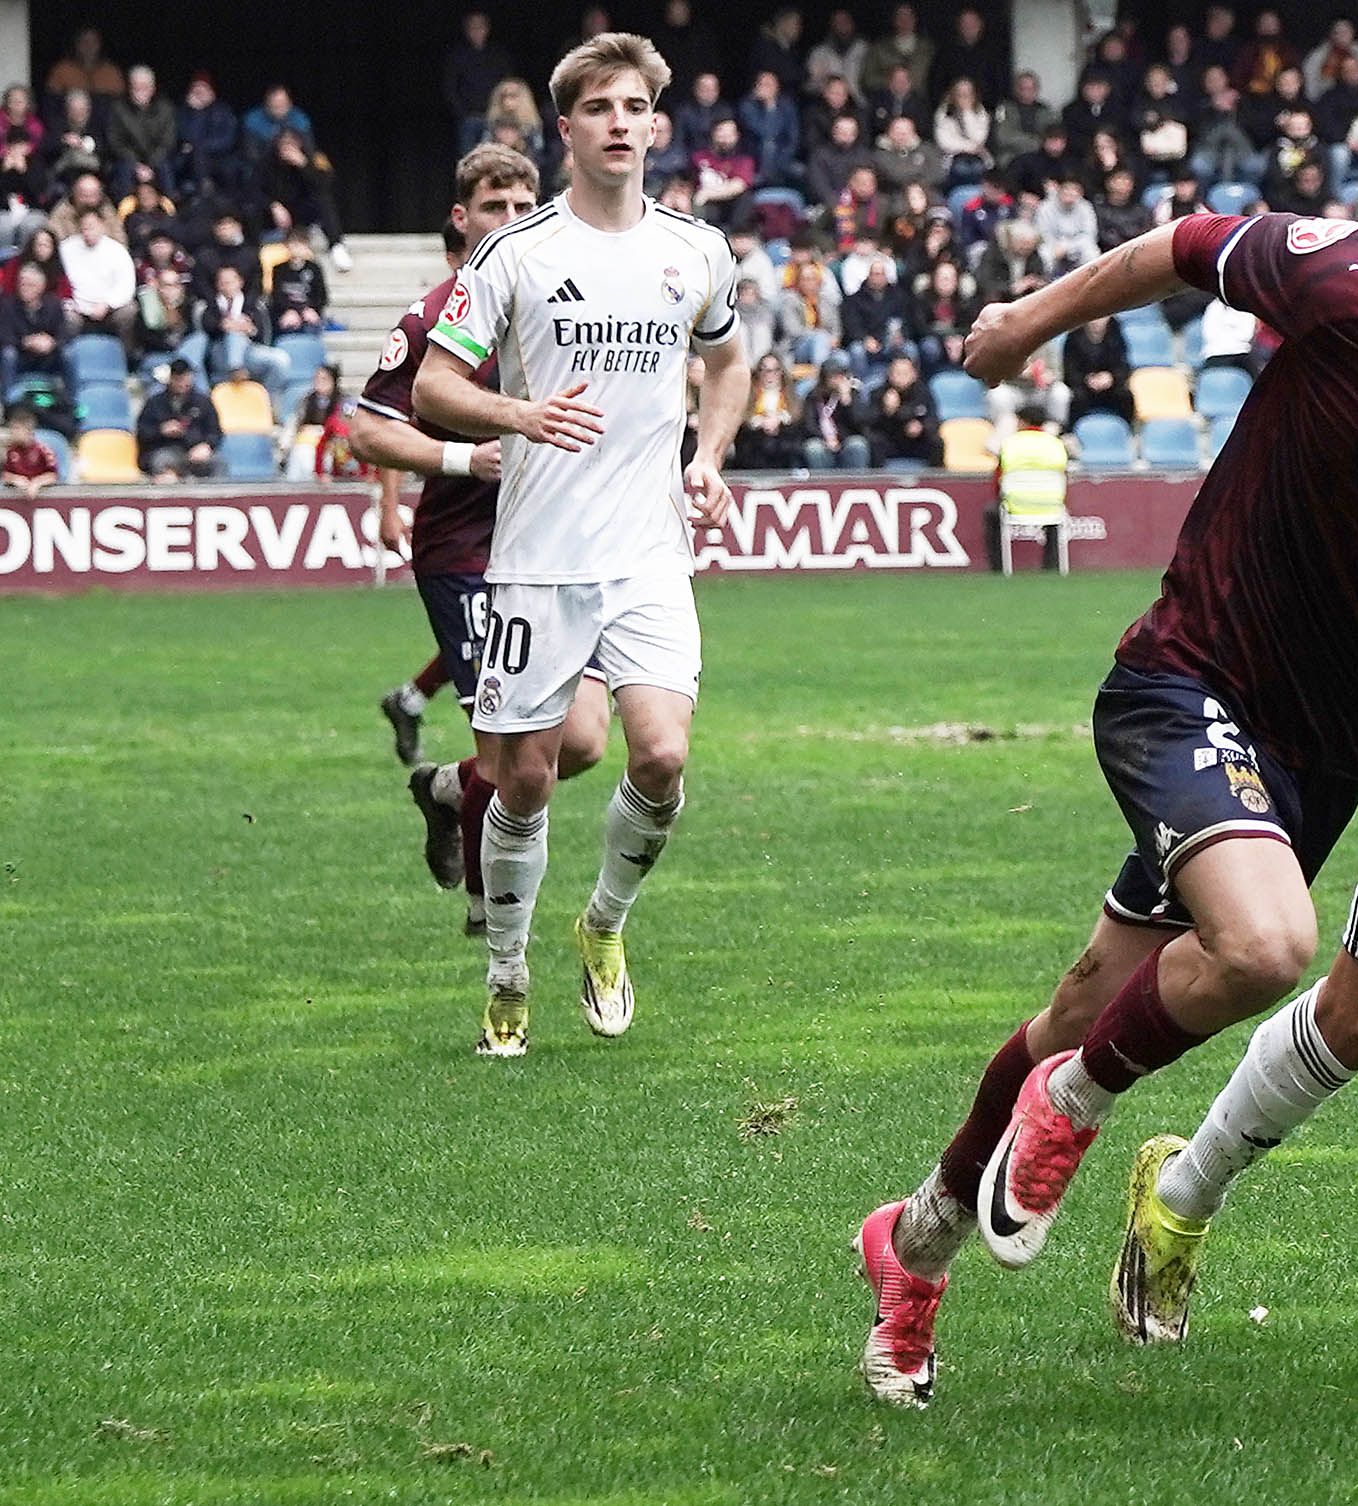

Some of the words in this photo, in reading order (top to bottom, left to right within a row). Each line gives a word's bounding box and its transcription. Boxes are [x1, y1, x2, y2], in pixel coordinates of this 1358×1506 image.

[553, 315, 679, 347] Emirates
[571, 350, 597, 373] FLY
[604, 350, 660, 374] BETTER
[486, 610, 531, 674] 10
